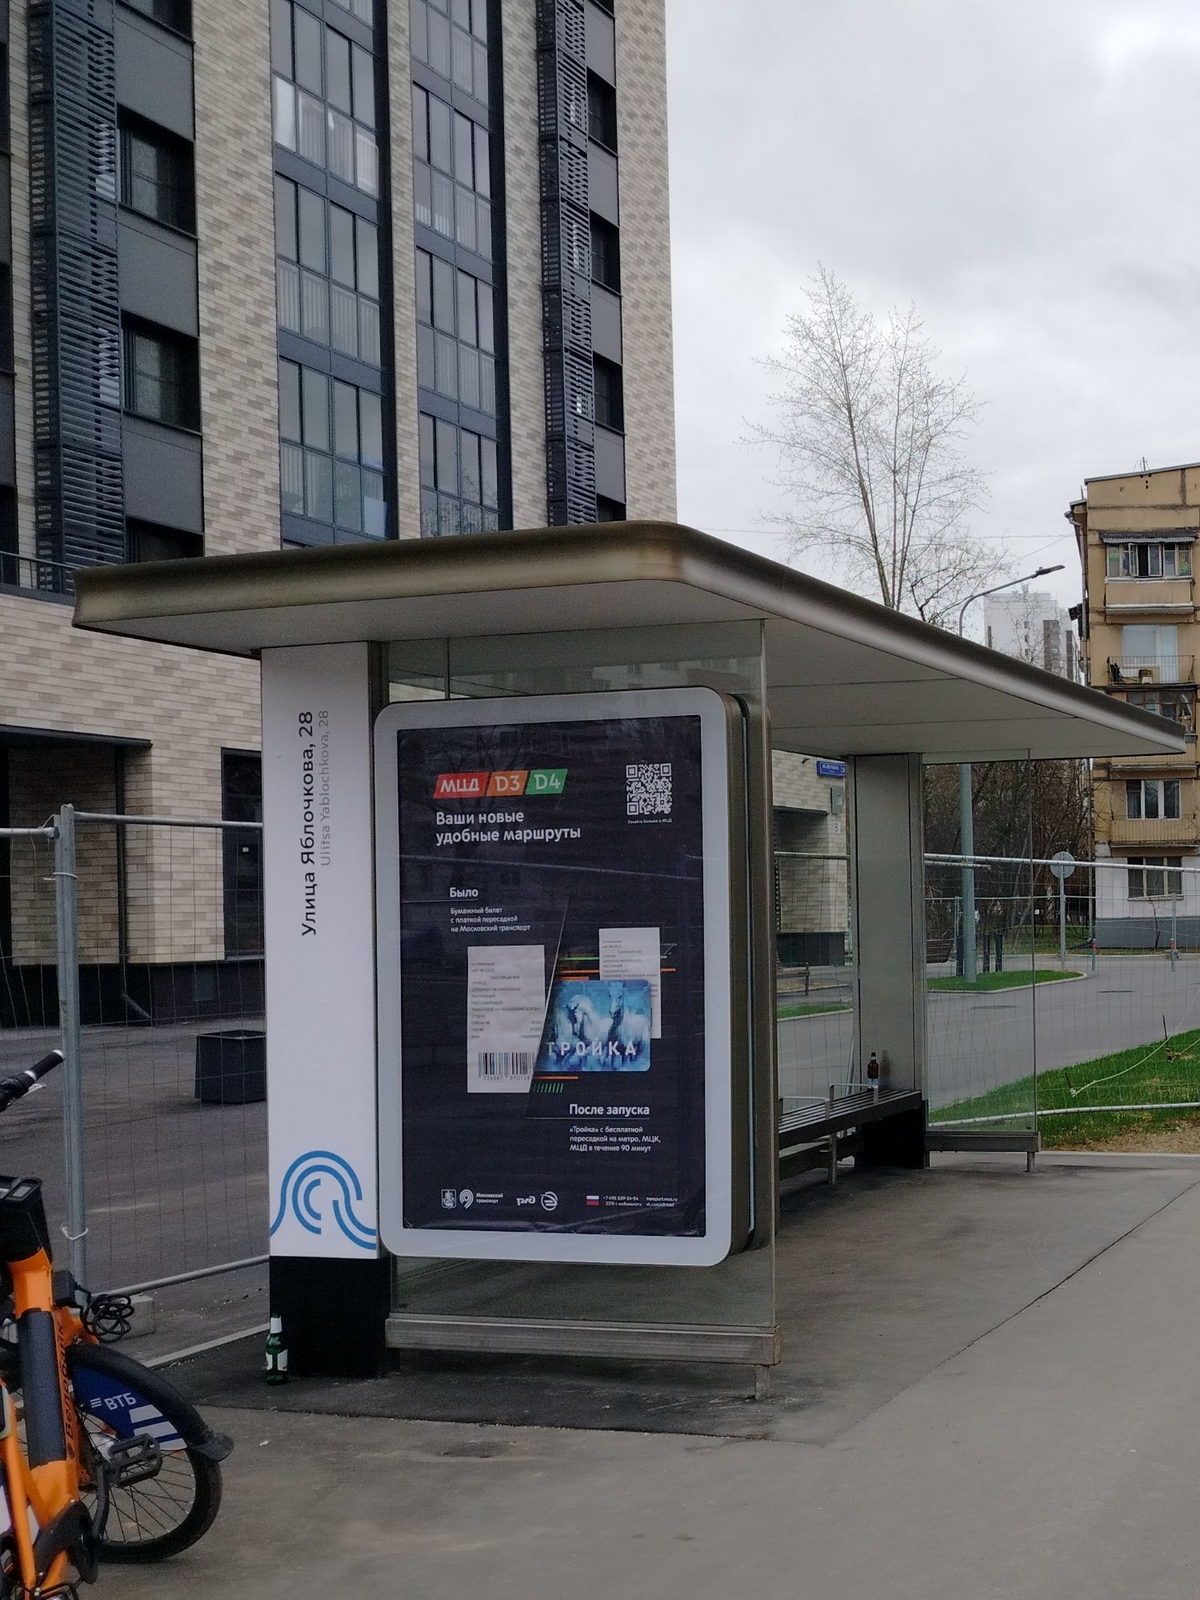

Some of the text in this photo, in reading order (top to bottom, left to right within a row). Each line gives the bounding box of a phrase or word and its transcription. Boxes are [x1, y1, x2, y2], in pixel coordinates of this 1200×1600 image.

[319, 710, 331, 866] Ulitsa Yablochkova, 28
[440, 773, 561, 793] МЦД D3 D4
[299, 711, 317, 936] Улица Яблочкова, 28
[436, 811, 524, 825] Ваши новые
[436, 826, 581, 846] удобные маршруты
[449, 887, 479, 898] Было
[450, 906, 503, 915] Бумажный билет
[482, 915, 518, 923] пересадкой
[546, 1039, 637, 1056] ТРОЙКА
[569, 1103, 650, 1117] После запуска
[569, 1144, 587, 1152] МЦД
[631, 1145, 651, 1153] минут
[104, 1392, 137, 1411] ВТБ
